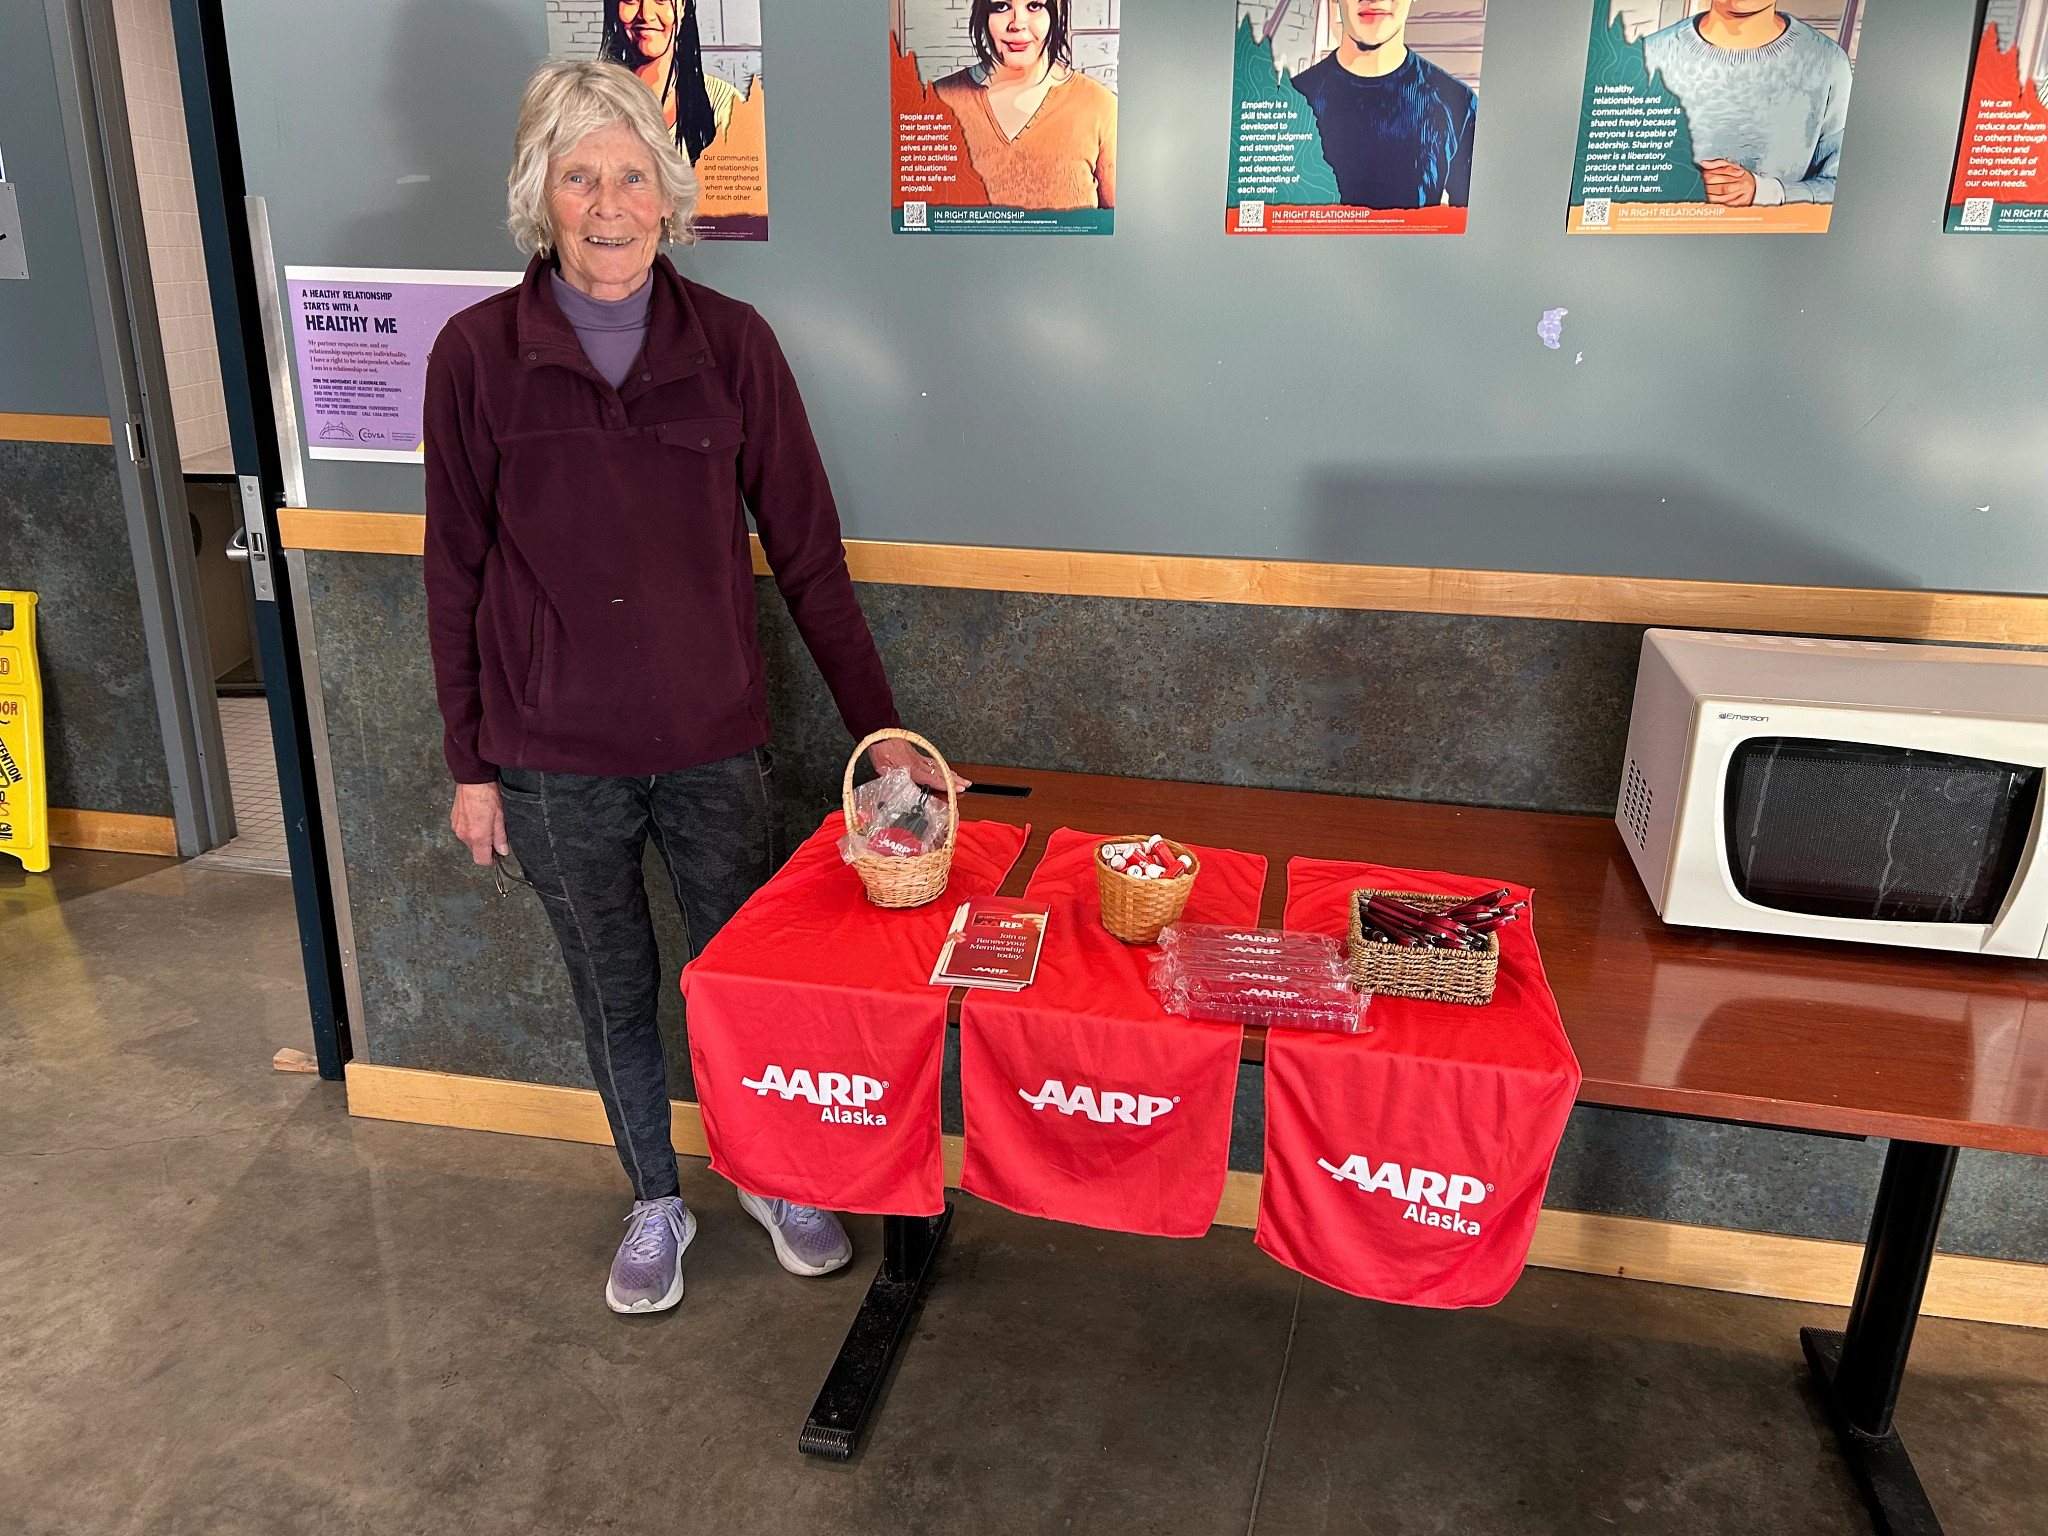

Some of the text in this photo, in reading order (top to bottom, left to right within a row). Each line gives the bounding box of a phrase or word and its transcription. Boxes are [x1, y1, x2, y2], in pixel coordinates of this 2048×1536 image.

[1594, 84, 1635, 94] In healthy
[1593, 95, 1661, 105] relationships and
[1242, 100, 1274, 110] Empathy
[1275, 100, 1282, 109] is
[1241, 112, 1255, 120] skill
[1256, 111, 1272, 119] that
[1287, 111, 1298, 119] be
[1592, 107, 1681, 116] communities, power is
[1978, 111, 2032, 120] intentionally
[900, 113, 922, 122] People
[900, 123, 916, 131] their
[1240, 122, 1288, 131] developed to
[1590, 118, 1676, 128] shared freely because
[1975, 122, 2006, 130] reduce
[2023, 122, 2047, 131] harm
[917, 133, 949, 141] authentic
[1277, 132, 1313, 142] judgment
[1589, 129, 1678, 139] everyone is capable of
[1974, 133, 2048, 144] to others through
[1239, 143, 1295, 152] and strengthen
[1588, 140, 1673, 150] leadership. Sharing of
[1971, 145, 2030, 154] reflection and
[1253, 154, 1294, 162] connection
[1586, 153, 1612, 162] power
[1613, 152, 1620, 160] is
[1627, 151, 1666, 160] liberatory
[1969, 156, 2039, 166] being mindful of
[914, 164, 947, 172] situations
[1238, 164, 1253, 173] and
[1254, 165, 1281, 174] deepen
[1585, 163, 1617, 172] practice
[1618, 163, 1635, 171] that
[1652, 162, 1673, 171] undo
[1967, 168, 2037, 176] each other's and
[716, 174, 759, 182] strengthened
[928, 174, 942, 182] safe
[943, 174, 956, 182] and
[1238, 174, 1300, 184] understanding of
[1583, 173, 1659, 182] historical harm and
[2001, 179, 2028, 187] needs.
[901, 184, 934, 193] enjoyable.
[1237, 186, 1255, 194] each
[1582, 184, 1663, 194] prevent future harm.
[934, 211, 1025, 219] IN RIGHT RELATIONSHIP
[1272, 210, 1370, 219] IN RIGHT RELATIONSHIP
[1618, 208, 1725, 216] IN RIGHT RELATIONSHIP
[2000, 209, 2042, 218] IN RIGHT
[309, 289, 340, 298] HEALTHY
[343, 290, 392, 300] RELATIONSHIP
[303, 302, 330, 311] STARTS
[332, 303, 351, 312] WITH
[305, 315, 398, 334] HEALTHY ME
[0, 701, 18, 715] OR
[1726, 713, 1769, 722] Emerson
[878, 839, 911, 853] AARP
[1224, 934, 1279, 943] AARP
[970, 944, 1025, 953] Membership
[1226, 947, 1282, 955] AARP
[1240, 988, 1299, 999] AARP
[820, 1107, 887, 1126] Alaska
[1403, 1203, 1481, 1236] Alaska
